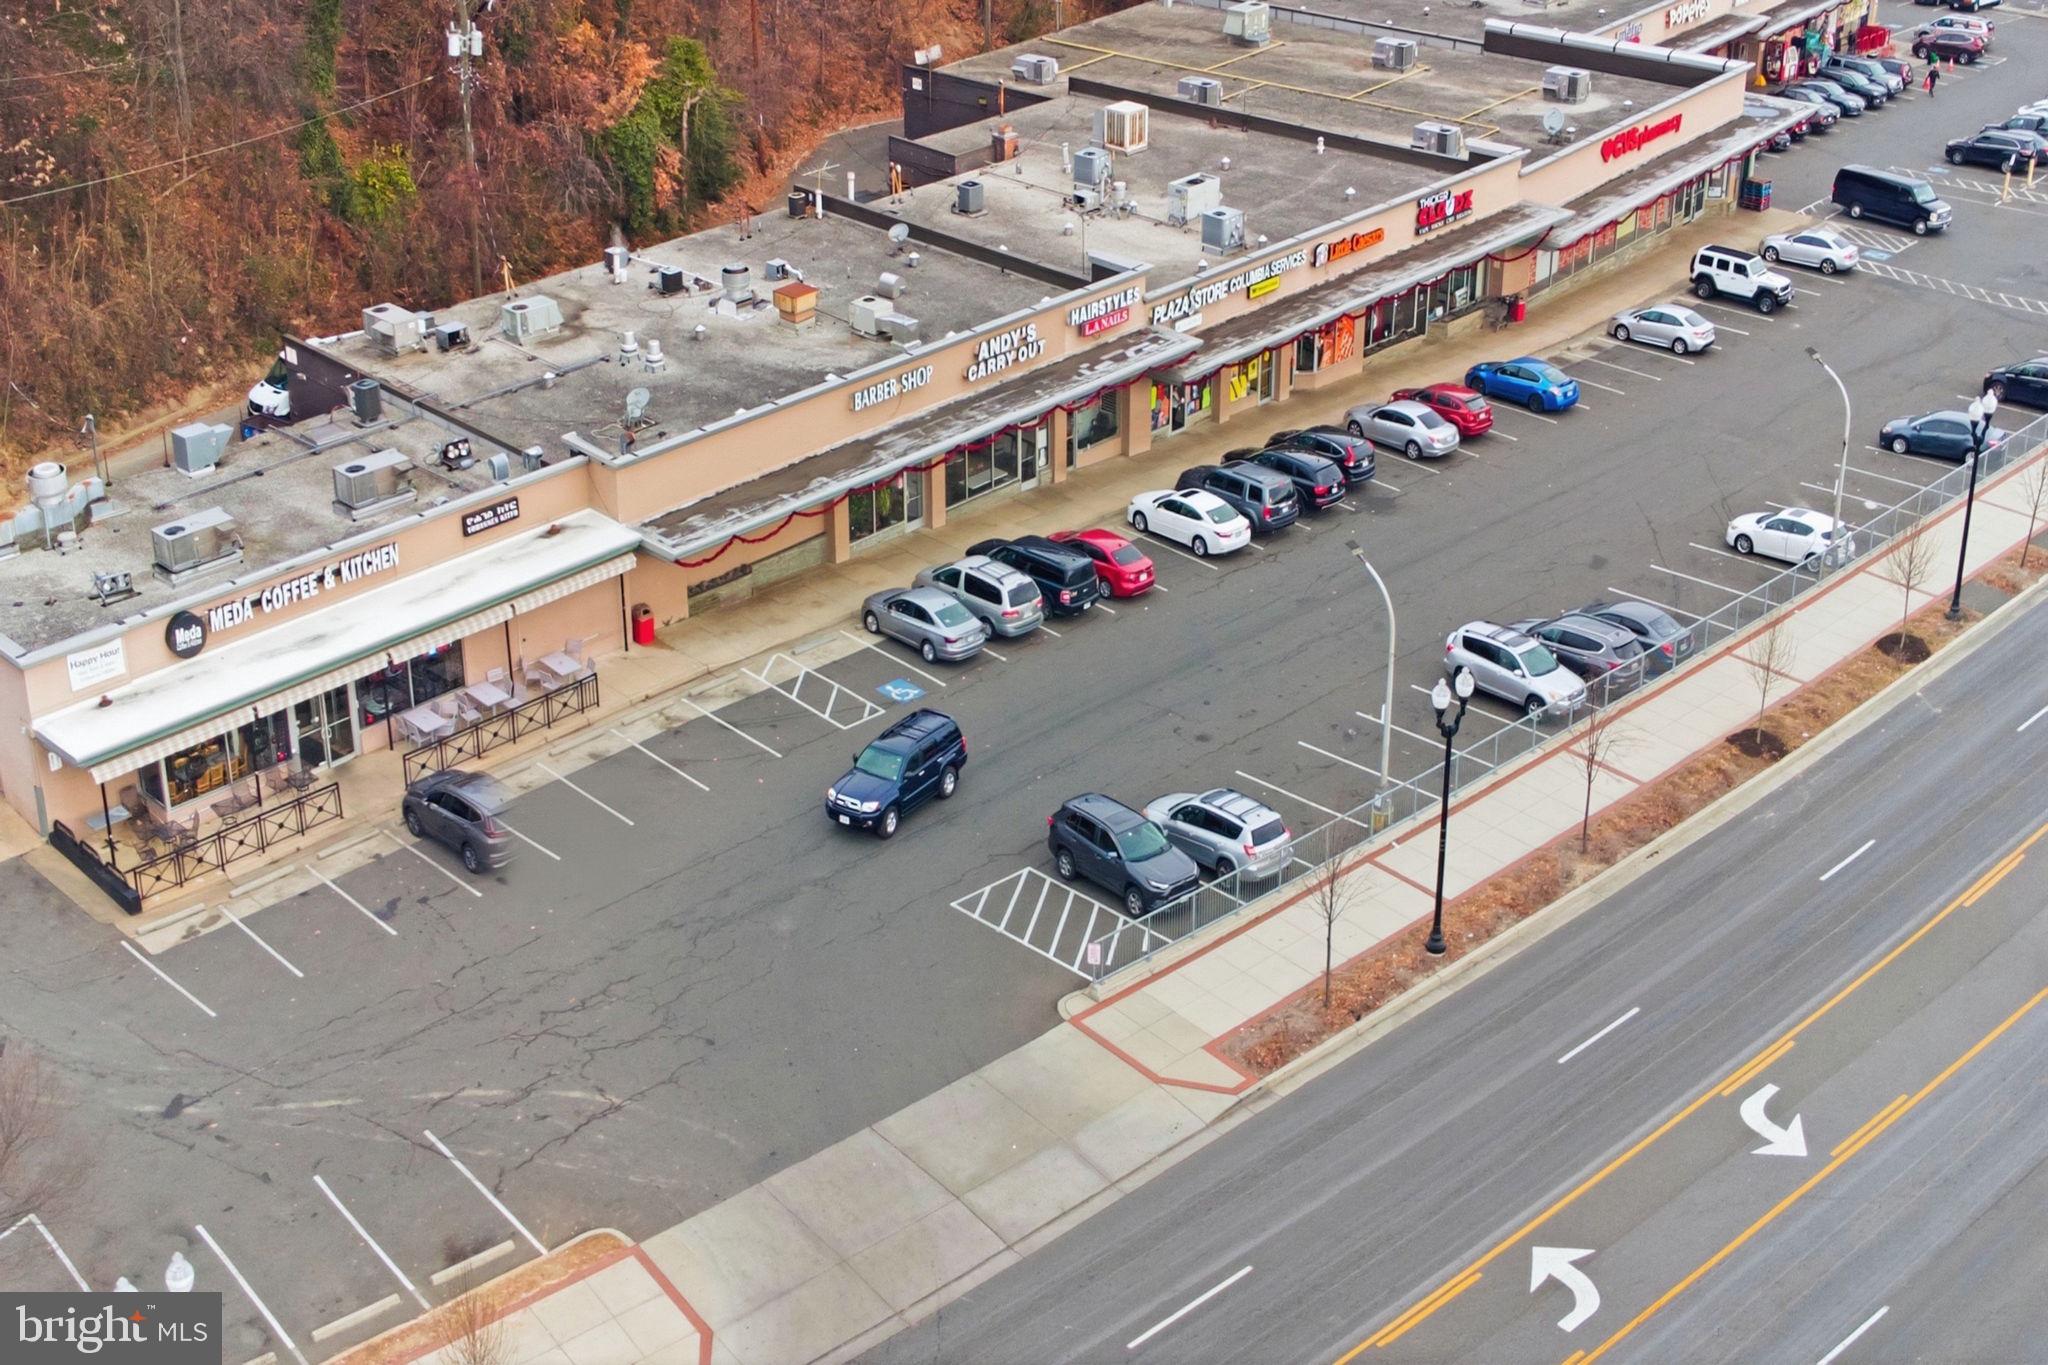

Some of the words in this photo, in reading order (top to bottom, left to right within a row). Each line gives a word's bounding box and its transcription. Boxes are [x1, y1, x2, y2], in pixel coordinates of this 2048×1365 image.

[1613, 127, 1639, 158] CVS
[1328, 238, 1351, 262] Little
[1352, 228, 1385, 252] Caesars
[1154, 295, 1189, 325] PLAZA
[1195, 280, 1228, 308] STORE
[1230, 264, 1271, 292] COLUMBIA
[1271, 249, 1307, 277] SERVICES
[1071, 287, 1140, 326] HAIRSTYLES
[1101, 310, 1128, 331] NAILS
[968, 352, 1014, 382] CARRY
[1018, 339, 1046, 363] OUT
[978, 323, 1037, 361] ANDY'S
[854, 378, 897, 411] BARBER
[901, 364, 934, 392] SHOP
[209, 597, 254, 633] MEDA
[260, 571, 319, 613] COFFEE
[322, 567, 336, 590] &
[340, 542, 400, 584] KITCHEN
[175, 624, 202, 645] Meda
[70, 655, 98, 670] Happy
